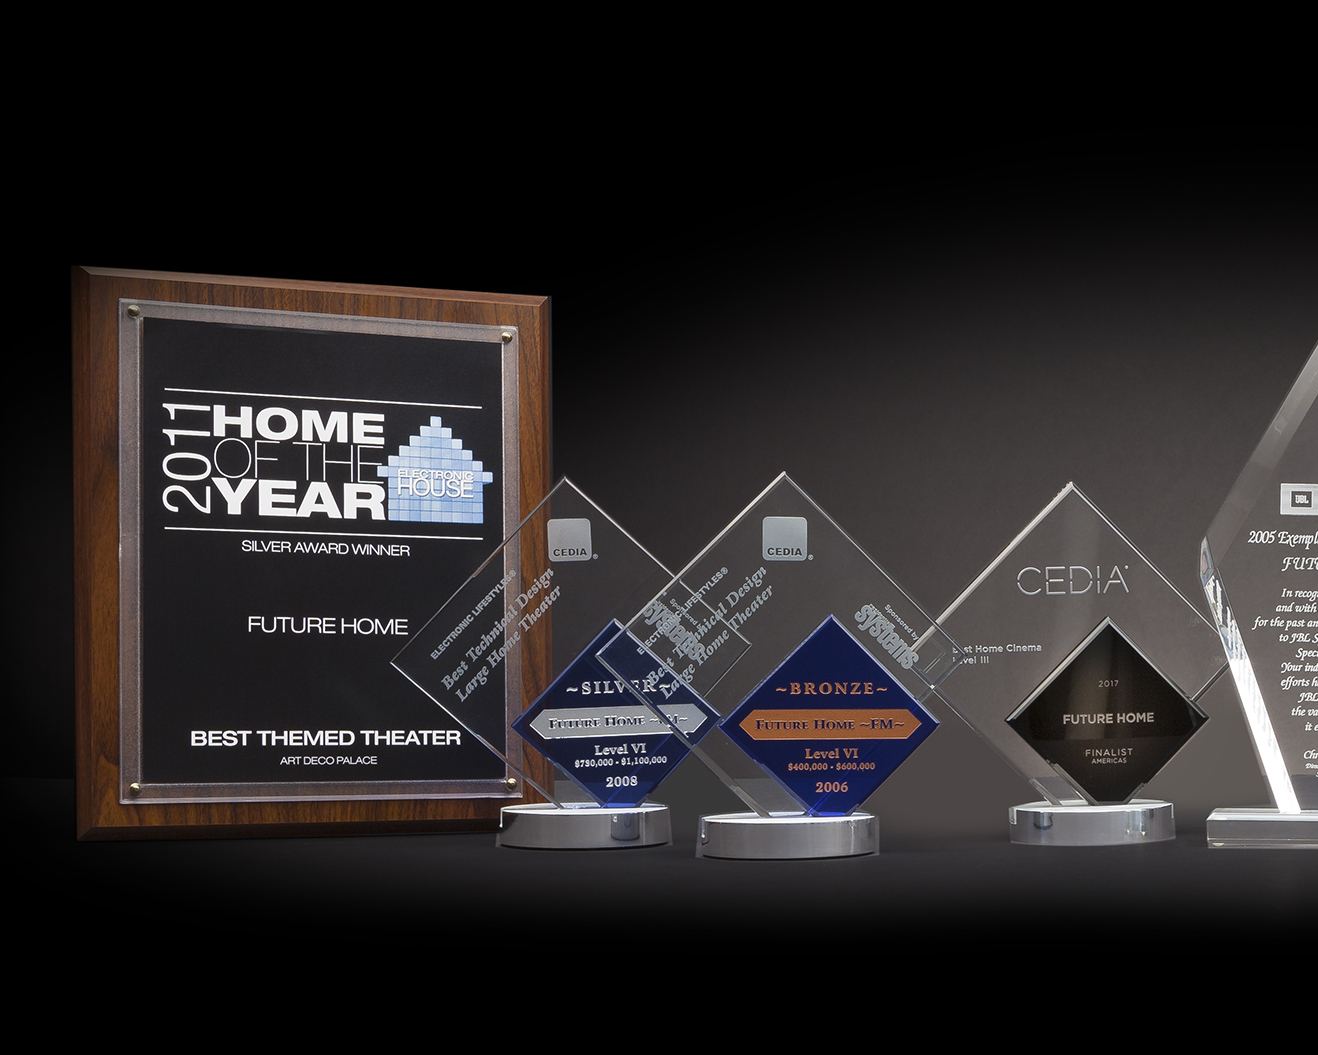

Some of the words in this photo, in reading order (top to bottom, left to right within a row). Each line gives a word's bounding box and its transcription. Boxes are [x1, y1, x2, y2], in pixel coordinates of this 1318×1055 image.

[213, 405, 385, 445] HOME
[162, 403, 211, 514] 2011
[214, 437, 280, 478] OF
[292, 442, 384, 483] THE
[398, 469, 474, 481] ELECTRONIC
[397, 478, 474, 498] HOUSE
[211, 477, 386, 520] YEAR
[1248, 530, 1277, 544] 2005
[241, 540, 291, 553] SILVER
[294, 542, 349, 555] AWARD
[352, 544, 410, 556] WINNER
[767, 548, 802, 556] CEDIA
[725, 566, 767, 608] Design
[1017, 565, 1129, 595] CEDIA
[728, 585, 773, 630] Theater
[1276, 603, 1293, 612] and
[1295, 603, 1316, 613] with
[248, 616, 336, 634] FUTURE
[341, 619, 408, 635] HOME
[885, 604, 913, 633] Sponsored
[1252, 617, 1268, 630] for
[1270, 618, 1284, 627] the
[1286, 619, 1305, 629] past
[441, 660, 468, 690] Best
[466, 605, 517, 662] Technical
[515, 568, 554, 609] Design
[430, 614, 474, 660] ELECTRONIC
[455, 664, 489, 701] Large
[486, 631, 520, 668] Home
[518, 586, 561, 632] Theater
[854, 605, 919, 669] systems
[975, 645, 1003, 653] Home
[1281, 662, 1302, 673] Your
[1281, 676, 1310, 690] efforts
[1292, 706, 1305, 716] the
[549, 718, 600, 729] FUTURE
[604, 715, 645, 726] HOME
[756, 719, 809, 730] FUTURE
[814, 719, 855, 729] HOME
[1063, 714, 1113, 725] FUTURE
[1116, 712, 1154, 723] HOME
[191, 731, 251, 746] BEST
[257, 731, 355, 746] THEMED
[360, 731, 461, 745] THEATER
[595, 744, 628, 755] Level
[631, 743, 646, 753] VI
[805, 749, 839, 759] Level
[844, 749, 858, 758] VI
[1085, 748, 1133, 757] FINALIST
[280, 756, 301, 764] ART
[304, 756, 334, 765] DECO
[337, 756, 377, 764] PALACE
[788, 763, 828, 771] $400,000
[836, 762, 875, 771] $600,000
[606, 776, 638, 787] 2008
[816, 782, 848, 793] 2006
